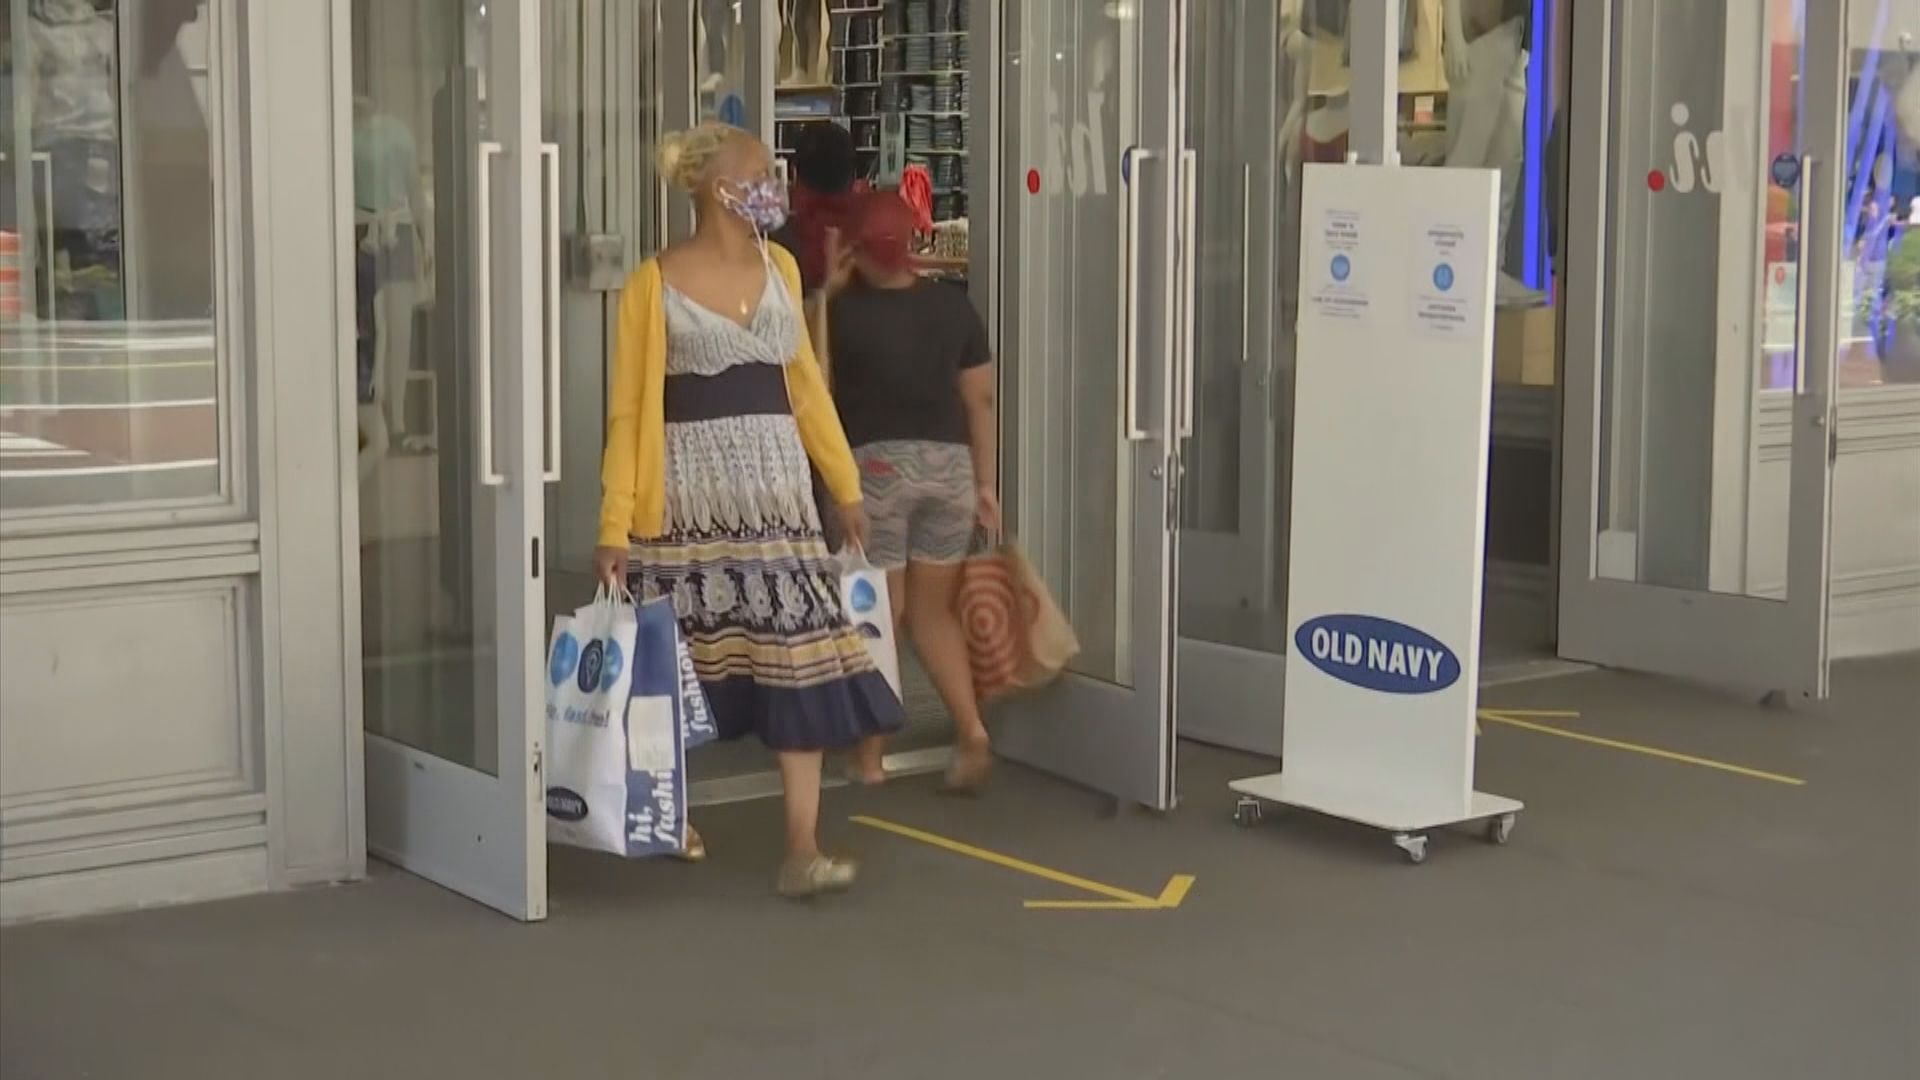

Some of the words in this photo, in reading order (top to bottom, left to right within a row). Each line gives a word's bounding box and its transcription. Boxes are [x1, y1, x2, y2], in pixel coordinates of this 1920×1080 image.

[1311, 627, 1363, 666] OLD
[1368, 637, 1443, 682] NAVY
[628, 806, 653, 843] hi,
[649, 768, 679, 849] fashi
